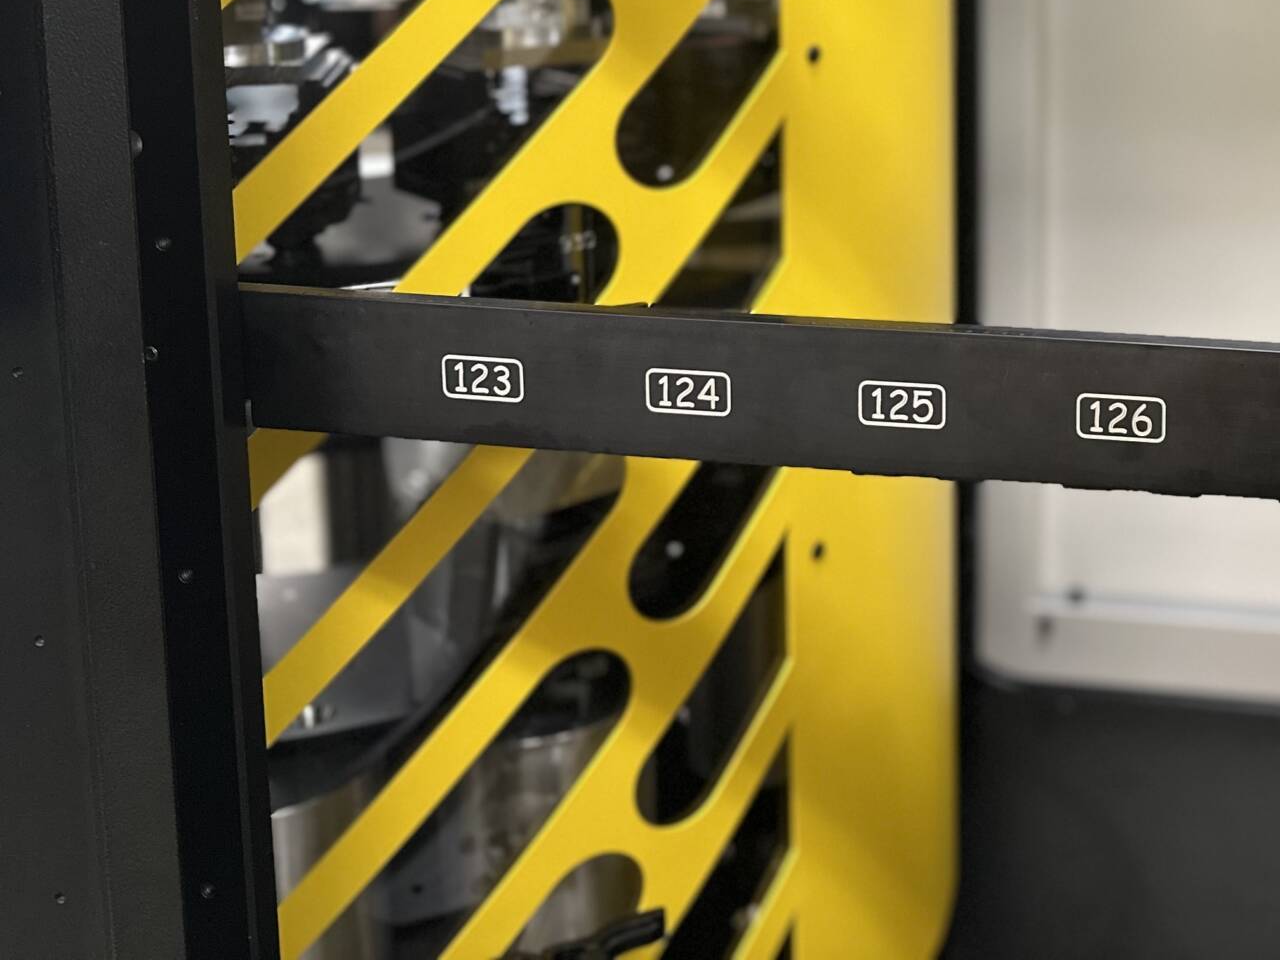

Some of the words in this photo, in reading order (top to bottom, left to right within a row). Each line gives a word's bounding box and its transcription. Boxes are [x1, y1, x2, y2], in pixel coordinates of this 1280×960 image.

[454, 361, 512, 396] 123
[658, 375, 720, 410] 124
[871, 387, 934, 423] 125
[1089, 400, 1153, 437] 126
